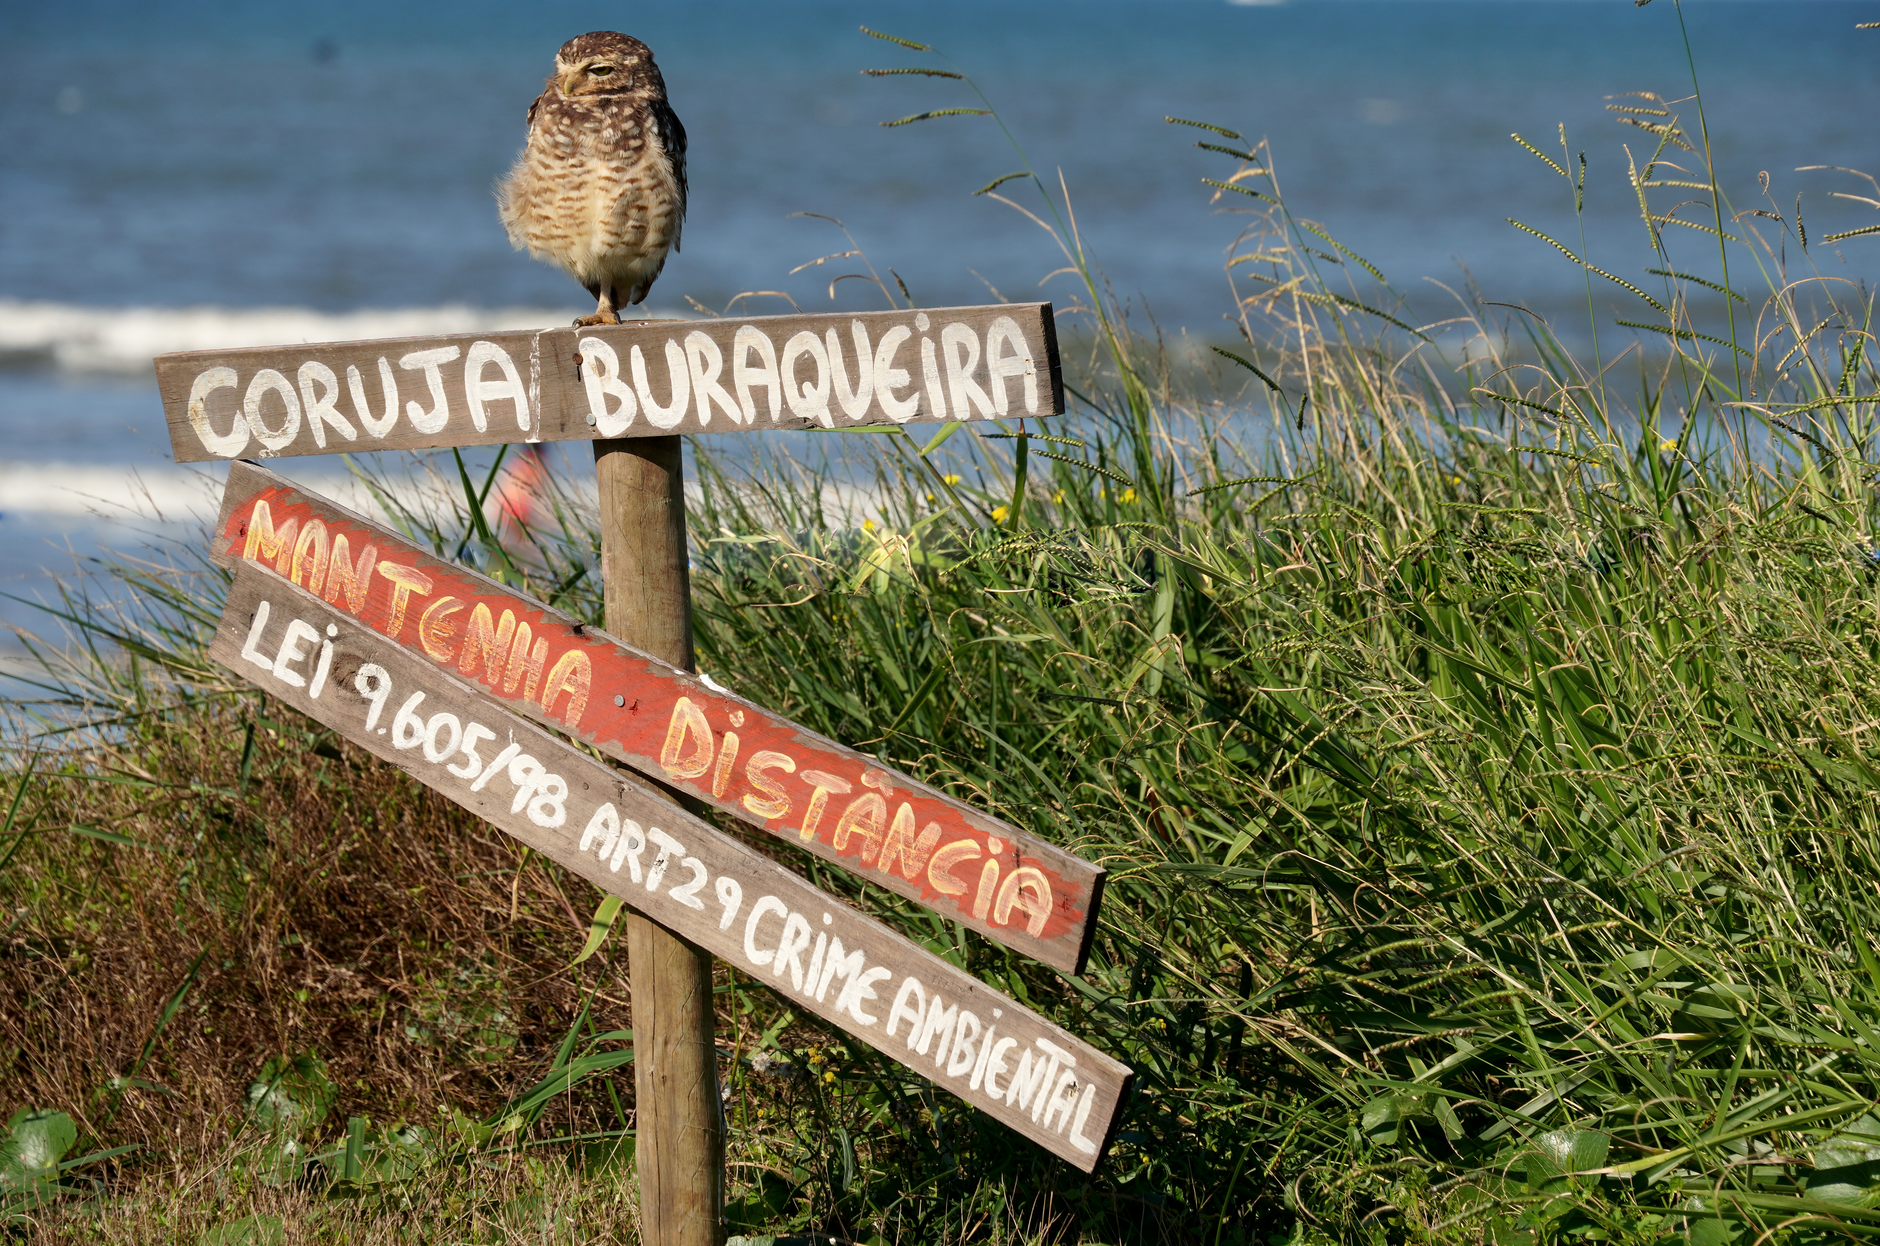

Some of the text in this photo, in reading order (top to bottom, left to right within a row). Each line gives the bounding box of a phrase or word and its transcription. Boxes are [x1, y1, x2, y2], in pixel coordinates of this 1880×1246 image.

[188, 340, 530, 458] CORUJA
[242, 500, 592, 728] MANTENHA
[355, 663, 569, 828] 9.605/98
